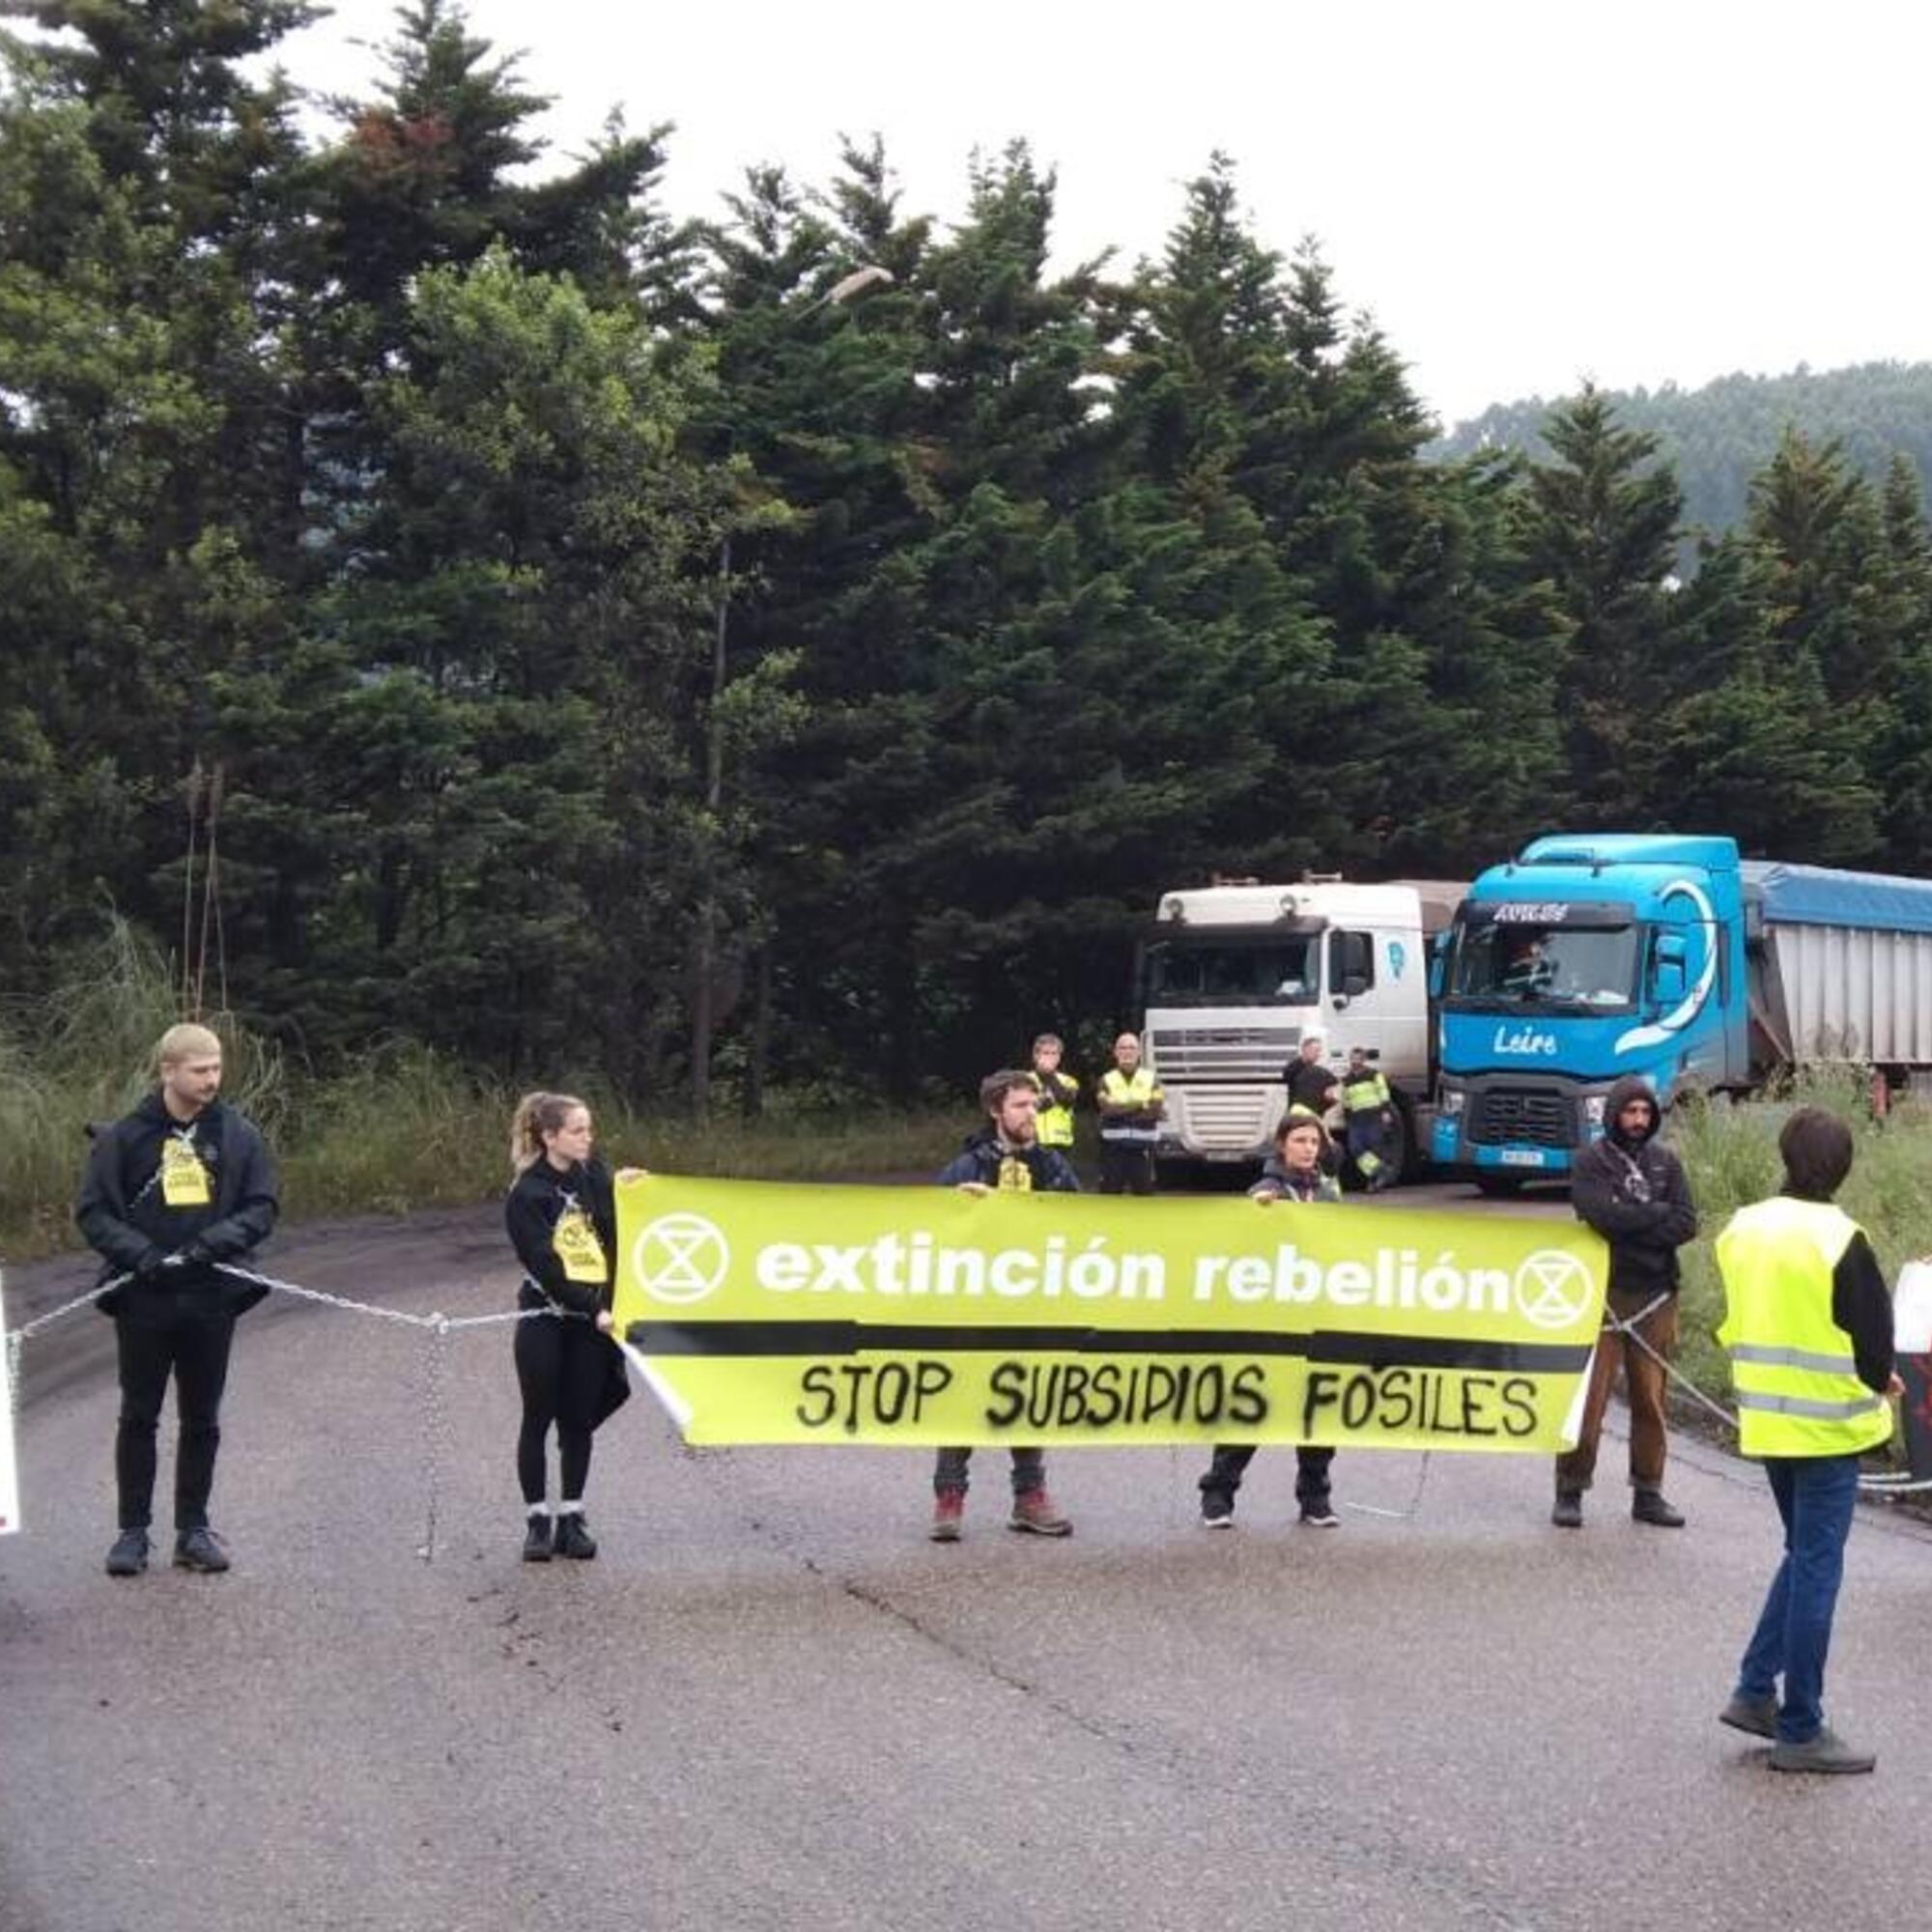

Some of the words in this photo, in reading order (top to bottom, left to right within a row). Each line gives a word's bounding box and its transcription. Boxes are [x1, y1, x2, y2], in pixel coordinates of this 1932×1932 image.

[755, 1232, 1167, 1298] extinción
[1194, 1244, 1509, 1313] rebelión
[796, 1361, 953, 1433] STOP
[985, 1363, 1269, 1428] SUBSIDIOS
